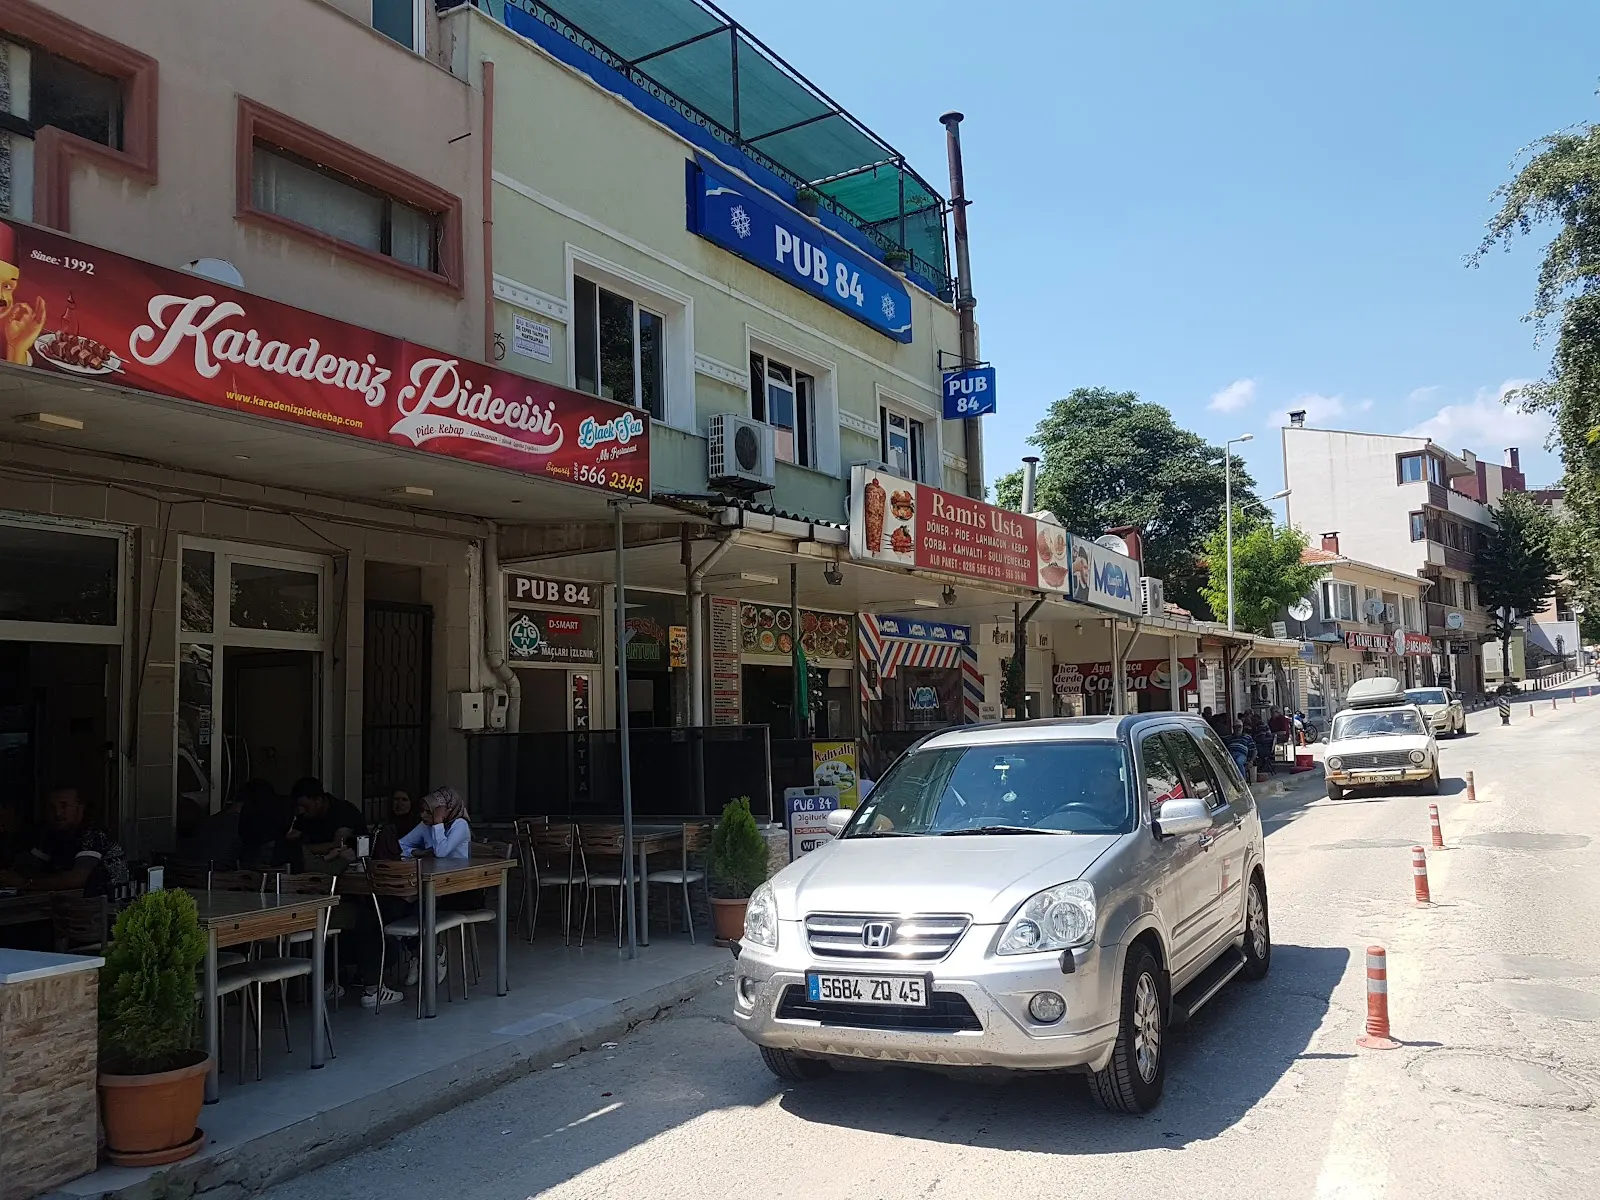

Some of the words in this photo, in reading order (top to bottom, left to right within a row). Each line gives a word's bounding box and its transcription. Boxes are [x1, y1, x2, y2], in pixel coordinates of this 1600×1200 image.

[30, 249, 61, 266] Since:
[63, 256, 95, 276] 1992
[774, 224, 829, 287] PUB
[835, 263, 865, 307] 84
[129, 294, 392, 408] Karadeniz
[397, 358, 560, 436] Pidecisi
[949, 376, 988, 397] PUB
[225, 390, 364, 428] www.karadenizpidekebap.com
[957, 397, 979, 412] 84
[415, 424, 435, 438] Pide
[438, 423, 465, 438] Kebap
[579, 417, 615, 448] Black
[614, 413, 643, 443] Sea
[580, 465, 606, 485] 566
[608, 471, 644, 493] 2345
[931, 492, 986, 529] Ramis
[990, 510, 1024, 539] Usta
[926, 519, 949, 537] DÖNER
[955, 526, 970, 541] PİDE
[975, 533, 1007, 550] LAHMACUN
[1011, 542, 1029, 554] KEBAP
[923, 536, 947, 552] ÇORBA
[952, 543, 983, 559] KAHVALTI
[988, 550, 1003, 563] SULU
[1003, 554, 1031, 569] YEMEKLER
[929, 553, 940, 565] ALO
[941, 556, 958, 569] PAKET
[1093, 557, 1133, 602] MODA
[516, 577, 560, 601] PUB
[563, 583, 591, 605] 84
[548, 619, 579, 630] D-SMART
[908, 623, 927, 637] MODA
[930, 626, 948, 639] MODA
[520, 637, 530, 645] TV
[951, 629, 967, 641] MODA
[1054, 673, 1083, 683] derde
[1058, 664, 1079, 674] her
[1091, 663, 1111, 675] Aya
[1126, 663, 1142, 674] aça
[1057, 683, 1080, 693] deva
[908, 686, 940, 711] MODA
[793, 798, 815, 811] PUB
[818, 797, 833, 810] 84
[812, 989, 817, 997] F
[821, 977, 863, 1000] 5684
[899, 981, 920, 1003] 45
